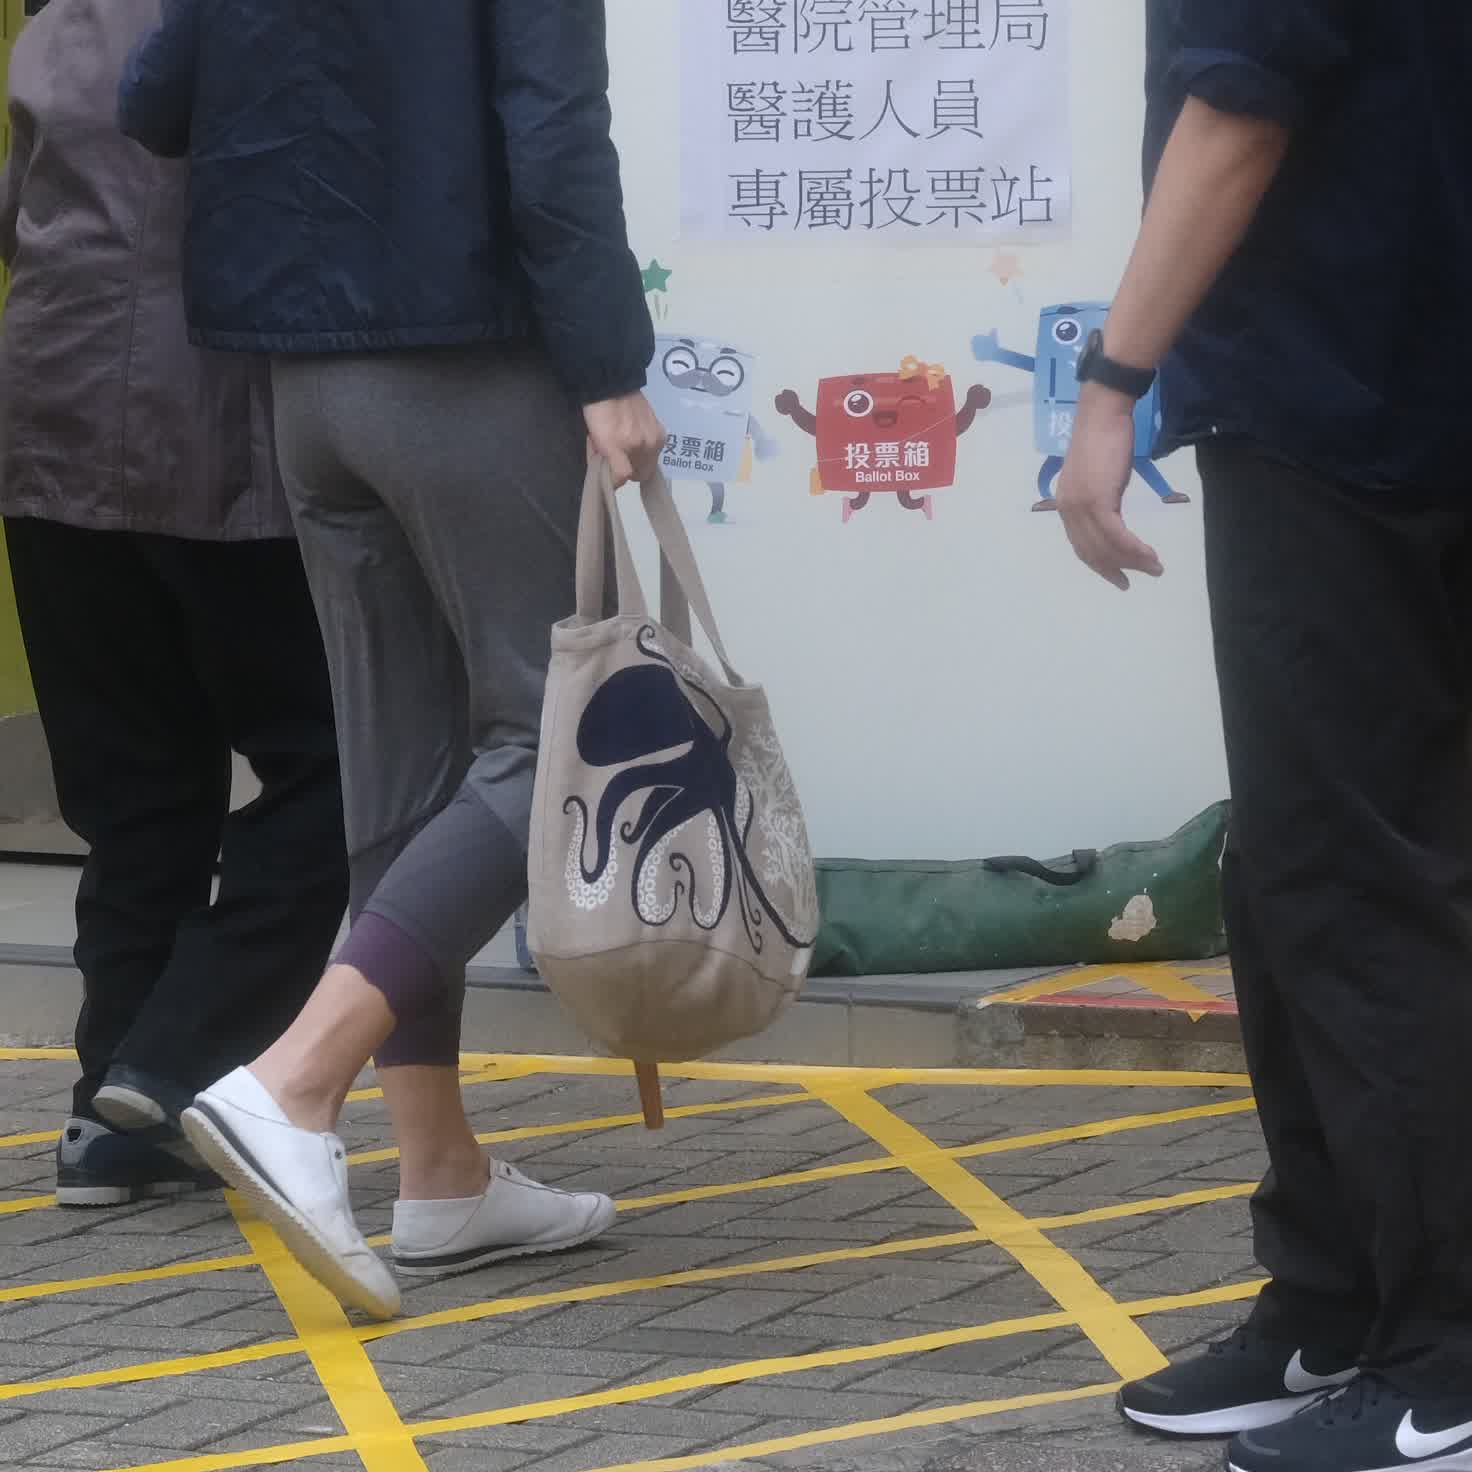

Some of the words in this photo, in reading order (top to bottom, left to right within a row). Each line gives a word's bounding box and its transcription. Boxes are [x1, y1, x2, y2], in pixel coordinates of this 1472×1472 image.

[726, 79, 985, 143] 醫護人員
[727, 165, 1054, 231] 專屬投票站
[661, 456, 694, 471] Ballot
[695, 459, 715, 473] Box
[844, 440, 930, 469] 投票箱
[854, 469, 891, 484] Ballot
[893, 469, 921, 483] Box
